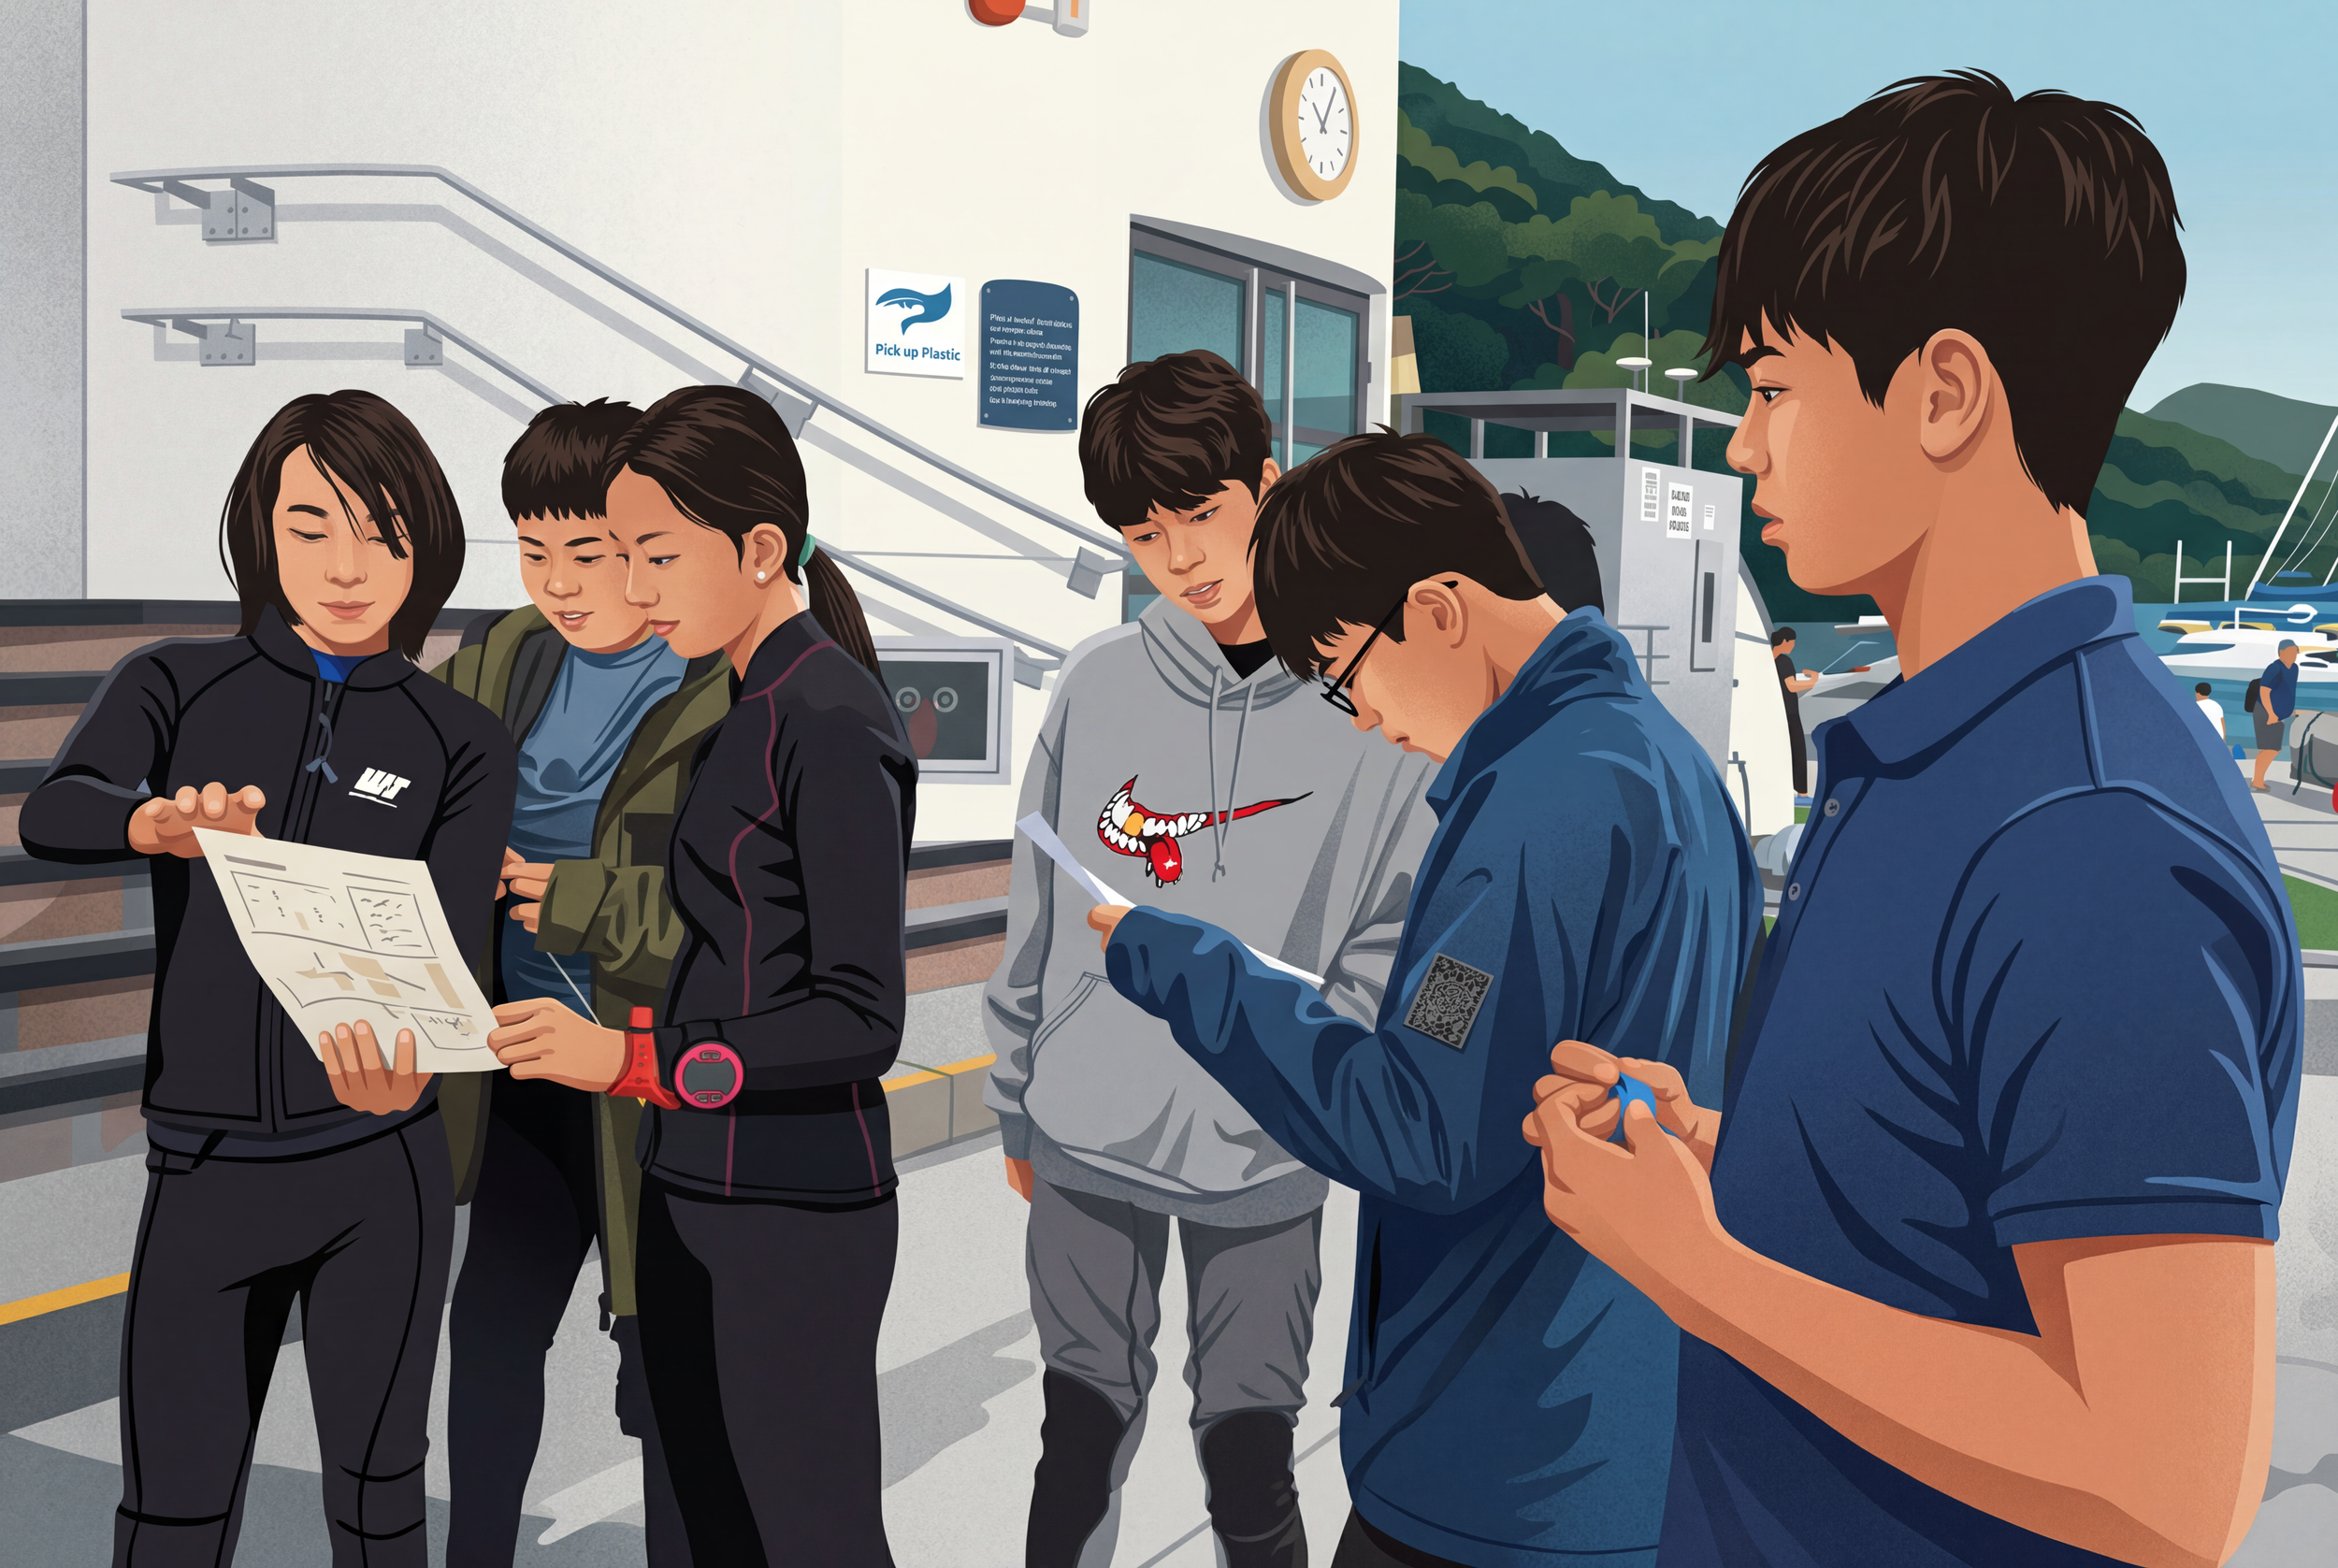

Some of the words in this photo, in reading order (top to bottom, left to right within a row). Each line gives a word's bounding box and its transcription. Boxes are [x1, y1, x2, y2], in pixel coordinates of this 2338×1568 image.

[875, 343, 902, 357] Pick
[903, 348, 919, 361] up
[921, 346, 961, 362] Plastic
